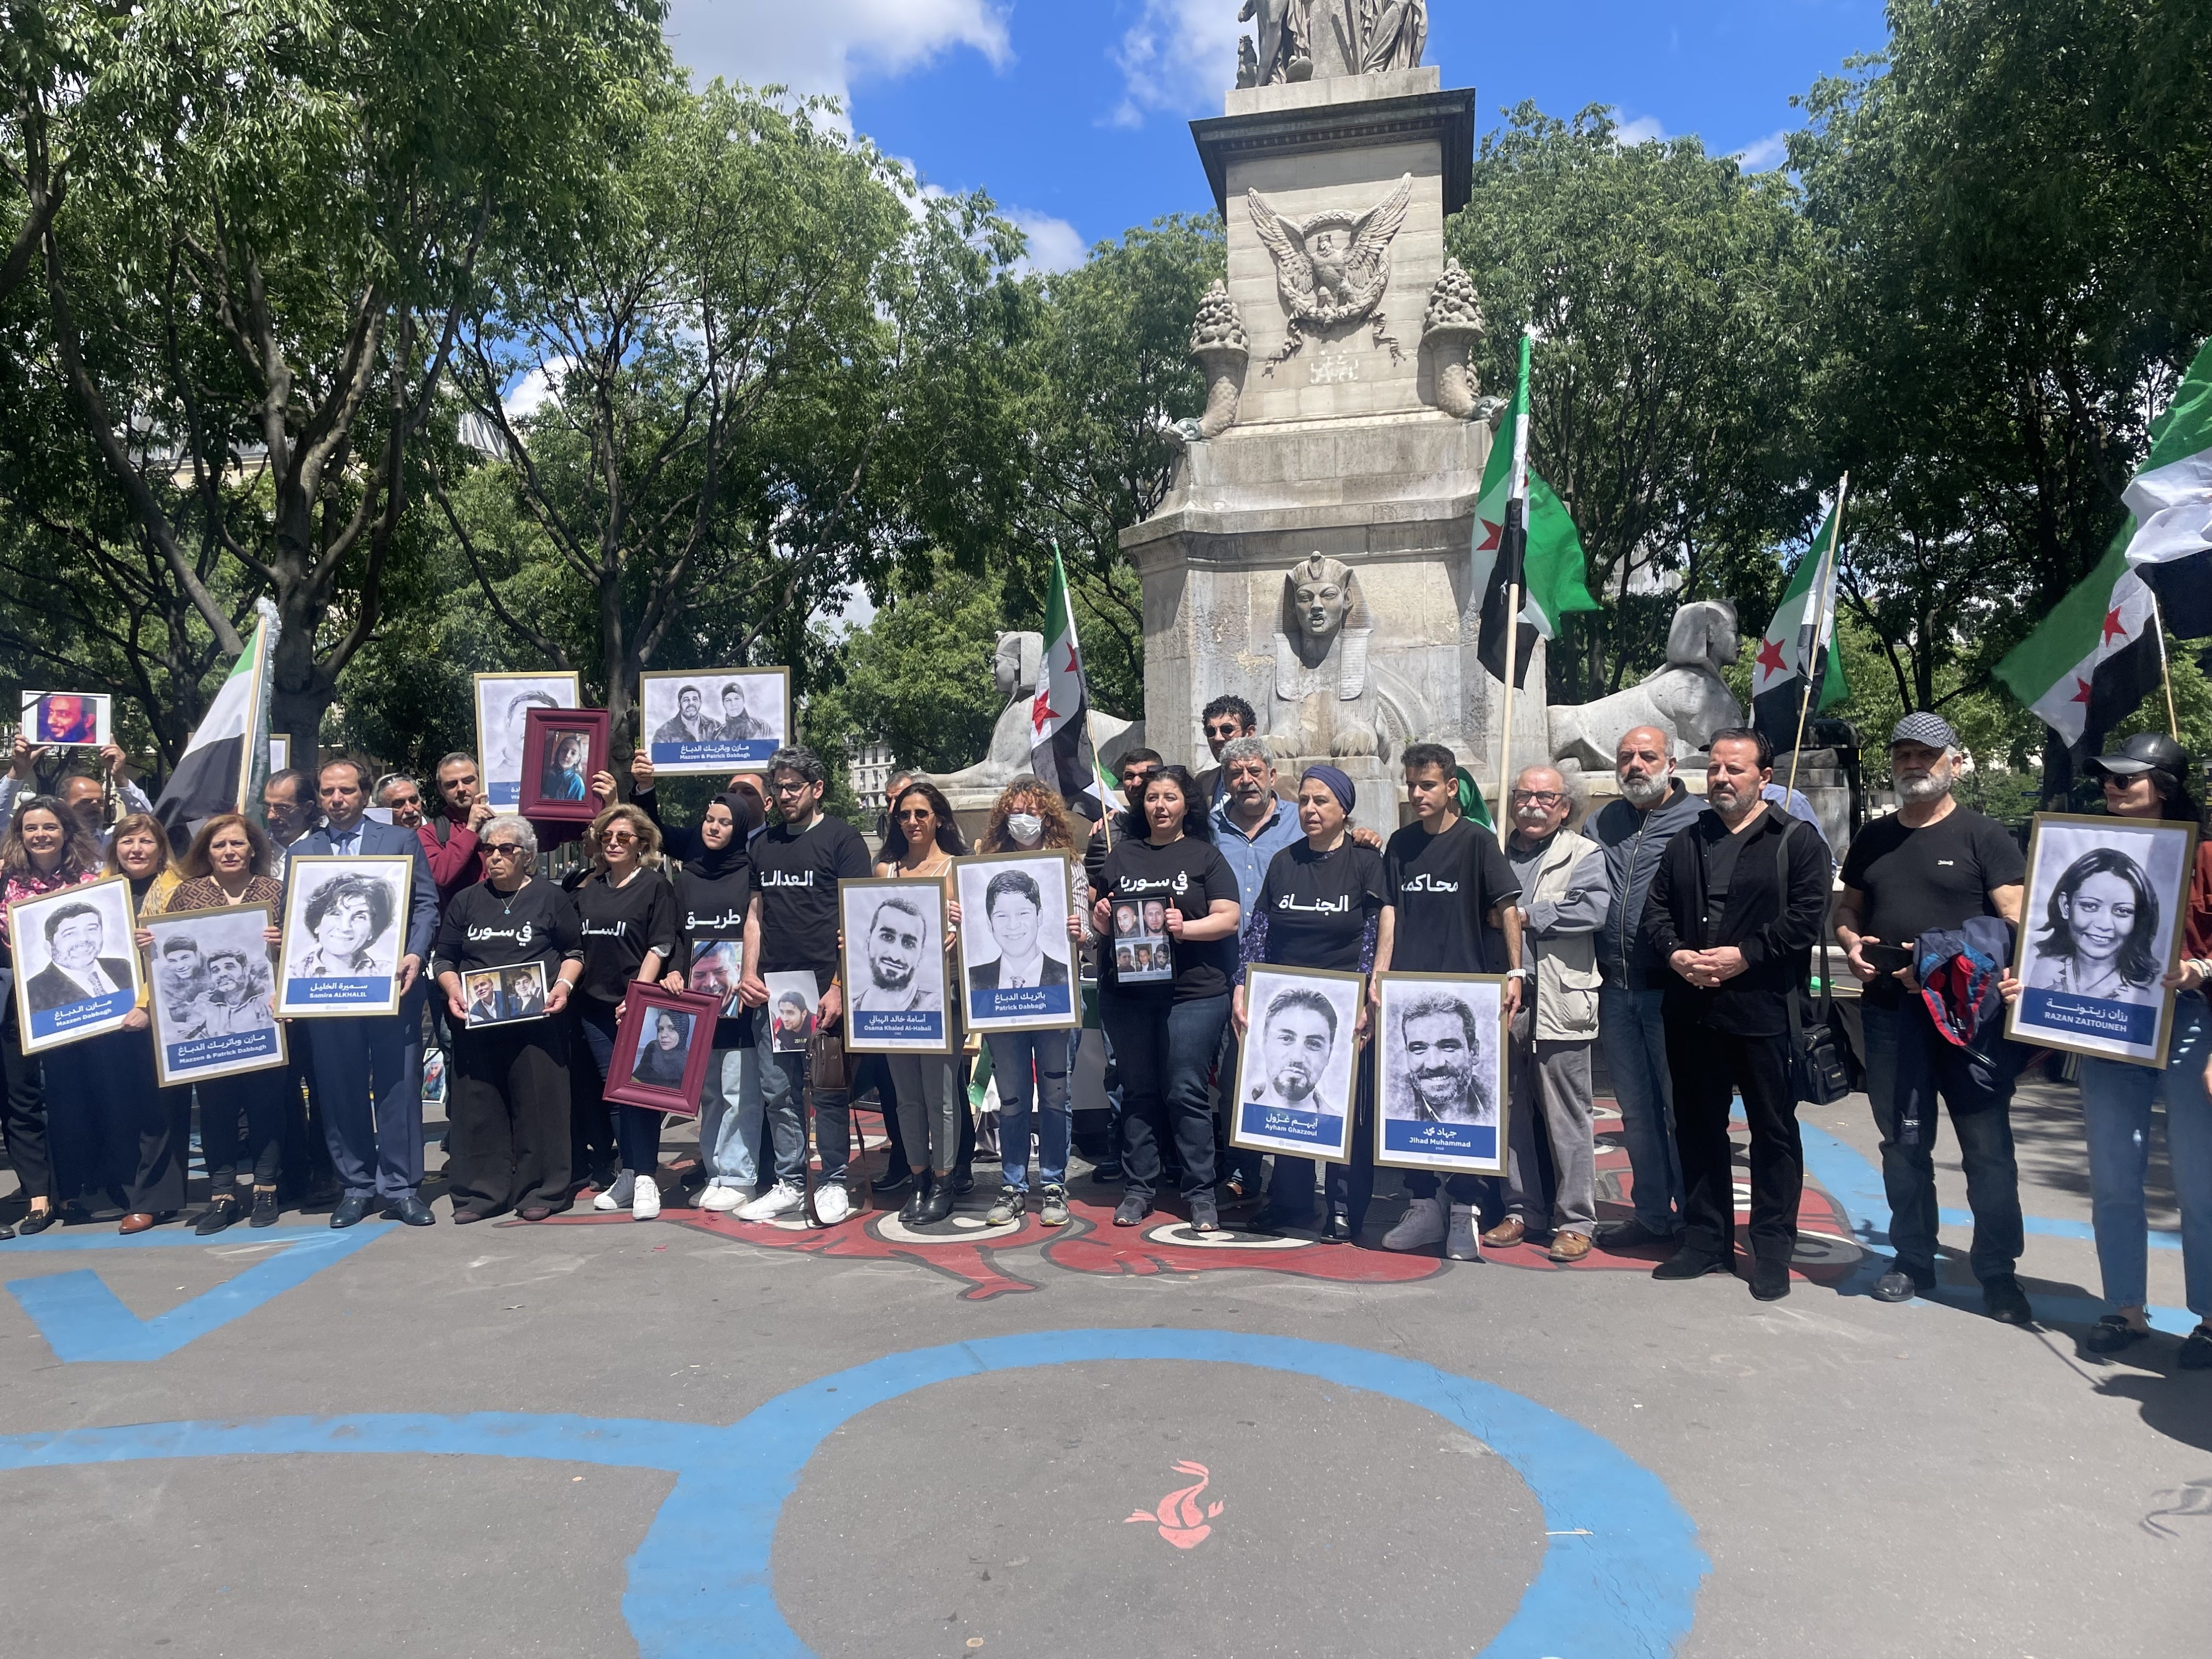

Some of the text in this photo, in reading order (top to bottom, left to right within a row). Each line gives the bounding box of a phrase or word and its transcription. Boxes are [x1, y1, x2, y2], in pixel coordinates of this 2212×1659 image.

[681, 745, 701, 754] الدباغ
[760, 870, 813, 886] العدالة
[1120, 870, 1188, 895] في سوريا
[1279, 893, 1349, 916] الجناة
[581, 919, 626, 937] السلا
[685, 909, 741, 930] طريق
[467, 921, 533, 946] في سوريا
[310, 982, 337, 992] الخليل
[995, 991, 1046, 1004] باتريك الدباغ
[55, 999, 112, 1020] مازن الدباغ
[56, 1008, 112, 1027] Mazzen Dabbagh
[907, 1014, 926, 1022] أسامة
[2046, 998, 2128, 1022] رزان زيتونة
[2044, 1011, 2127, 1032] RAZAN ZAITOUNEH
[178, 1034, 266, 1057] مازن وباتريك الدباغ
[179, 1055, 205, 1064] Mazzen
[213, 1050, 236, 1058] Patrick
[238, 1044, 267, 1054] Dabbagh
[1265, 1123, 1317, 1136] Ayham Ghazzoul
[1291, 1118, 1318, 1129] أيهم
[1423, 1126, 1457, 1139] جهاد محمد
[1430, 1139, 1471, 1147] Muhammad
